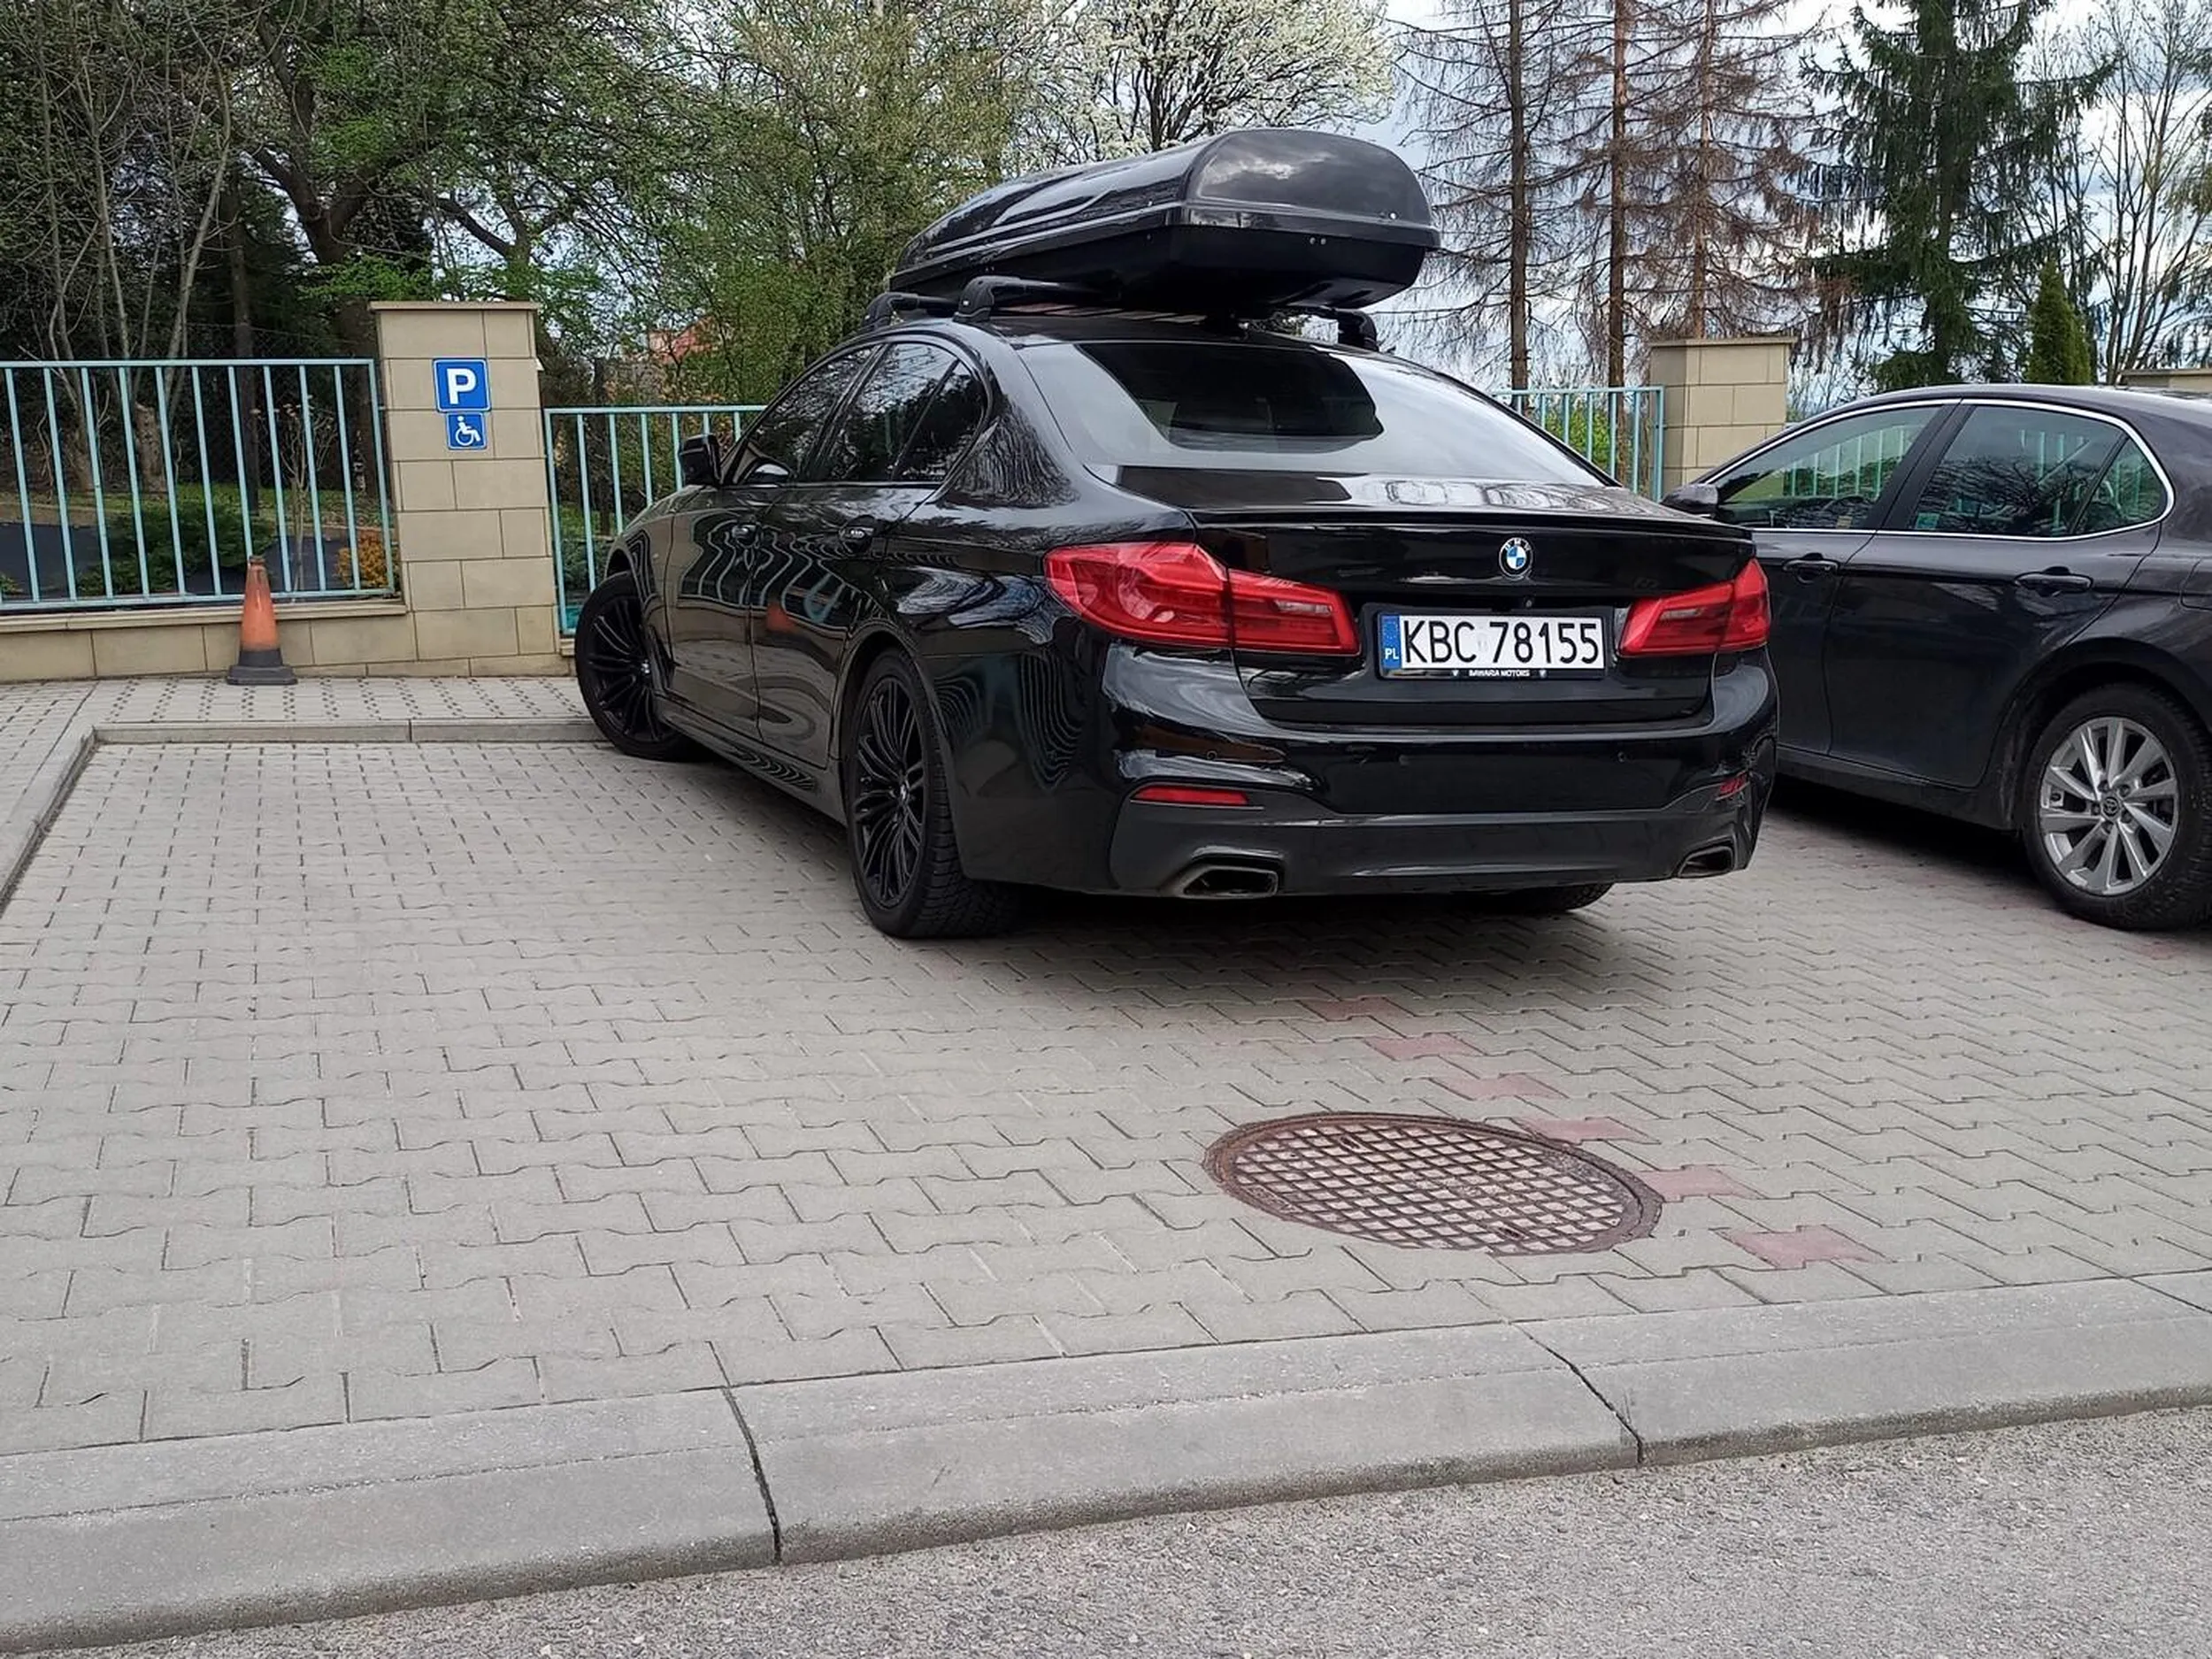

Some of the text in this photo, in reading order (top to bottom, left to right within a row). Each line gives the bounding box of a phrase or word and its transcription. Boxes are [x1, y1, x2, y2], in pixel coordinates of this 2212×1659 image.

[447, 368, 476, 404] P
[1385, 648, 1400, 660] PL
[1403, 620, 1599, 664] KBC 78155
